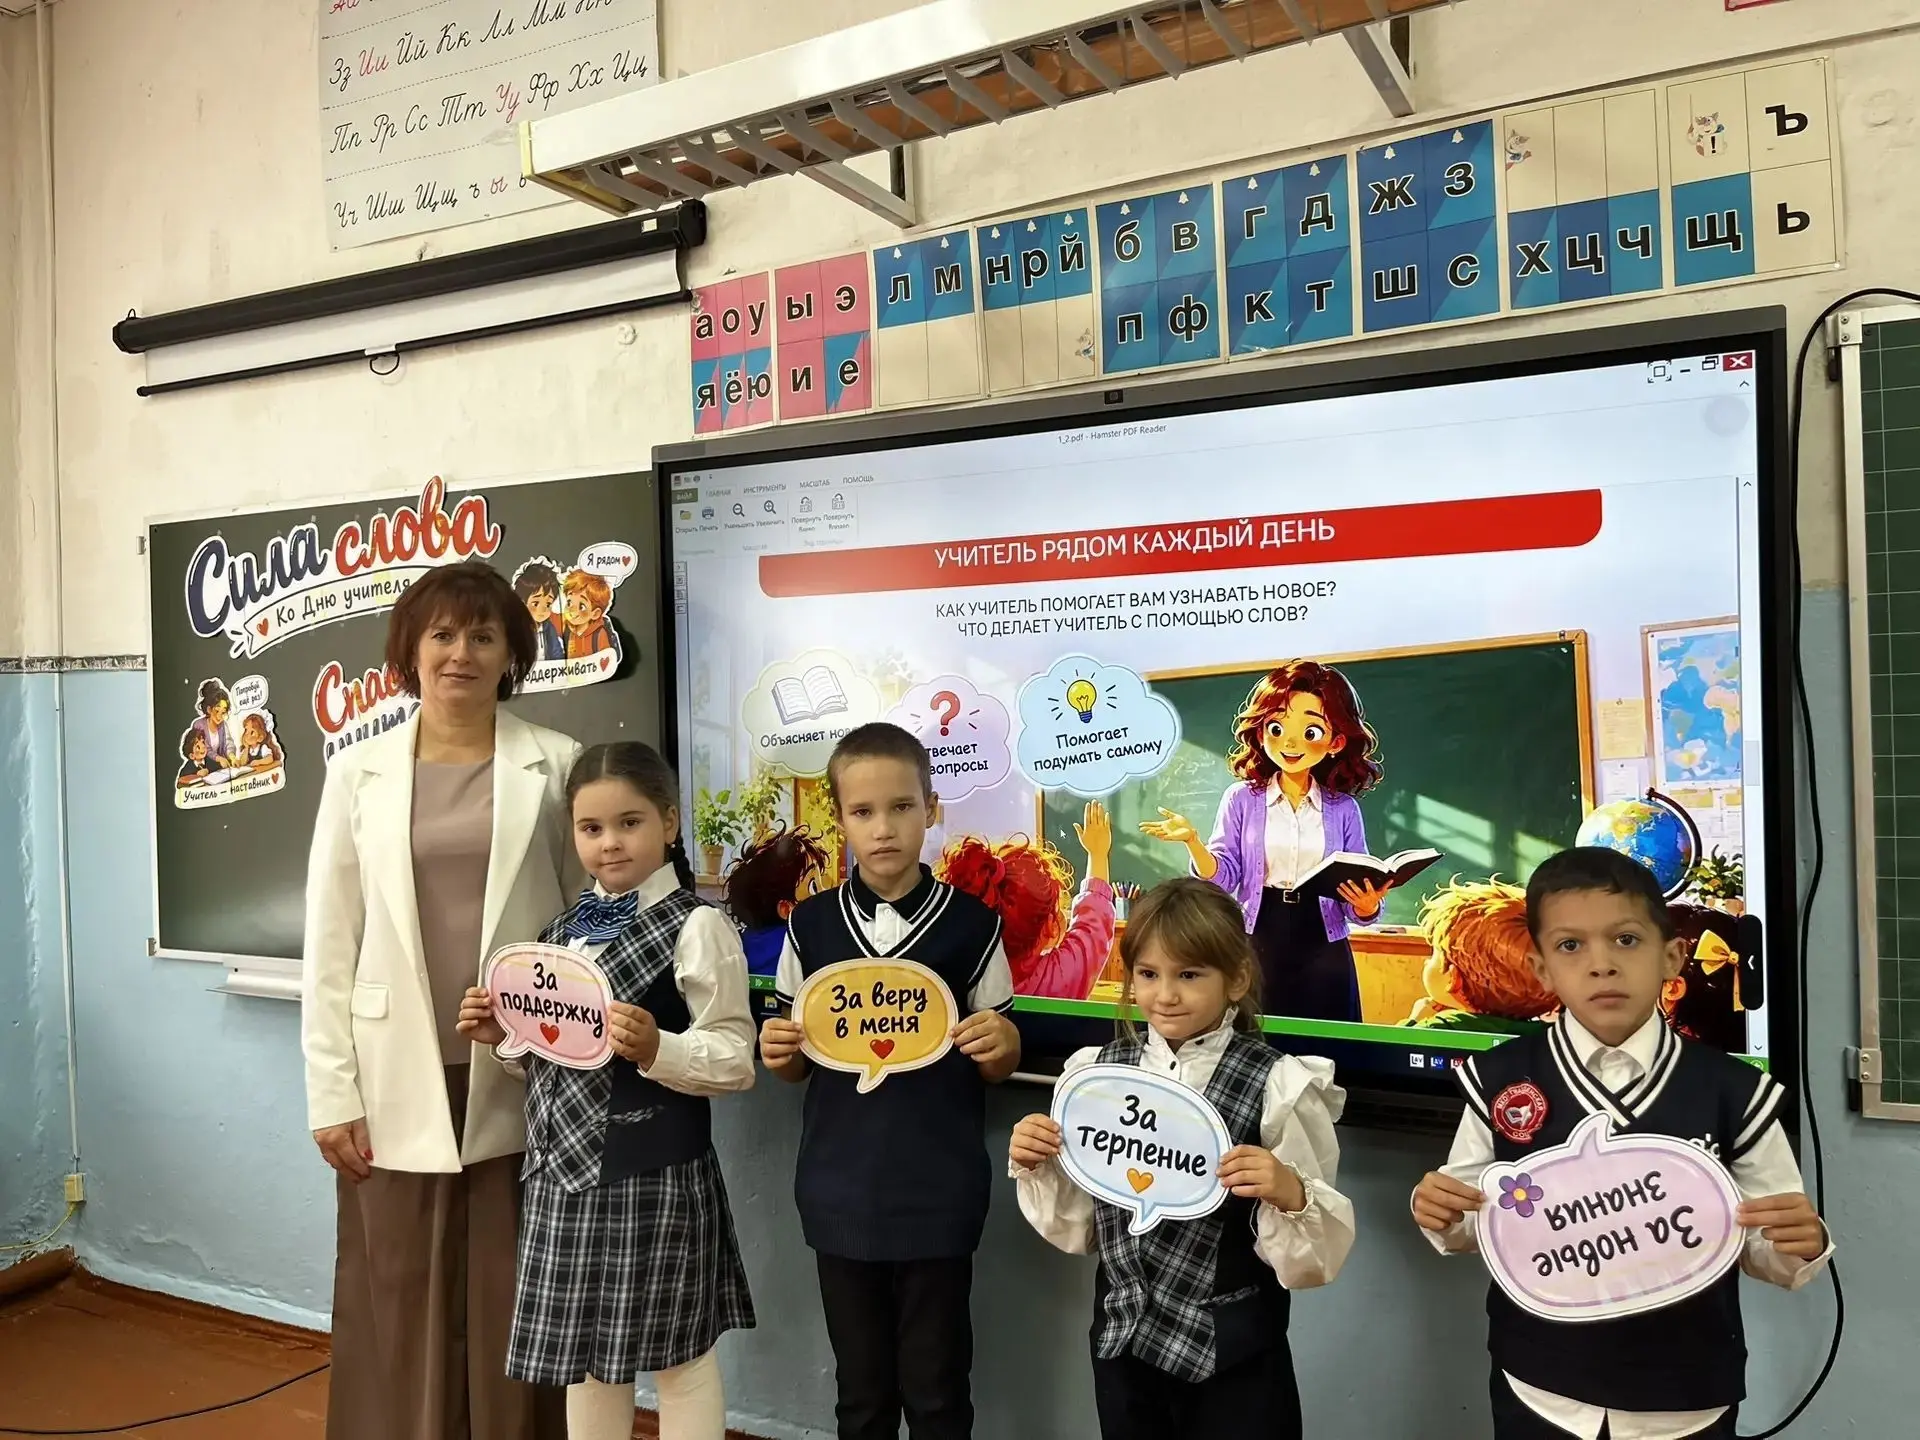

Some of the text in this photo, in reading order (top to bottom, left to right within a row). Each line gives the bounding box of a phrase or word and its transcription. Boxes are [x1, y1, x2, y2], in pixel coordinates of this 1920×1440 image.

[329, 58, 351, 92] Зз
[358, 46, 389, 76] Ии
[396, 32, 428, 66] Йй
[436, 22, 472, 54] Кк
[480, 8, 515, 43] Лл
[523, 0, 566, 31] Мм
[330, 50, 648, 153] Пп Рр Сс Тт Уу Фф Хх Цц
[333, 201, 358, 228] Чч
[366, 191, 405, 220] Шш
[415, 181, 458, 212] Щщ
[1114, 219, 1142, 263] б
[1058, 434, 1084, 444] 1_2.pdf
[1091, 430, 1121, 440] Hamster
[1123, 427, 1138, 436] PDF
[1140, 424, 1167, 434] Reader
[743, 484, 786, 494] ИНСТРУМЕНТЫ
[800, 479, 830, 488] МАСШТАБ
[843, 475, 874, 484] ПОМОЩЬ
[188, 475, 500, 634] Сила слова
[935, 518, 1336, 568] УЧИТЕЛЬ РЯДОМ КАЖДЫЙ ДЕНЬ
[587, 553, 621, 568] Я рядом
[276, 578, 410, 627] Ко Дню учителя
[936, 580, 1337, 618] КАК УЧИТЕЛЬ ПОМОГАЕТ ВАМ УЗНАВАТЬ НОВОЕ?
[958, 605, 1308, 637] ЧТО ДЕЛАЕТ УЧИТЕЛЬ С ПОМОЩЬЮ СЛОВ?
[524, 661, 598, 683] оддерживать
[760, 731, 826, 748] Объясняет
[925, 743, 978, 759] твечает
[1056, 726, 1129, 749] Помогает
[929, 759, 989, 777] вопросы
[1034, 739, 1163, 771] подумать самому
[183, 790, 218, 803] Учитель
[230, 777, 270, 794] наставник
[533, 962, 558, 991] За
[830, 981, 928, 1013] За веру
[500, 992, 604, 1038] поддержку
[835, 1015, 919, 1039] в меня
[1119, 1094, 1158, 1132] За
[1077, 1125, 1207, 1177] терпение
[1543, 1170, 1667, 1232] знания
[1531, 1205, 1702, 1277] За новые
